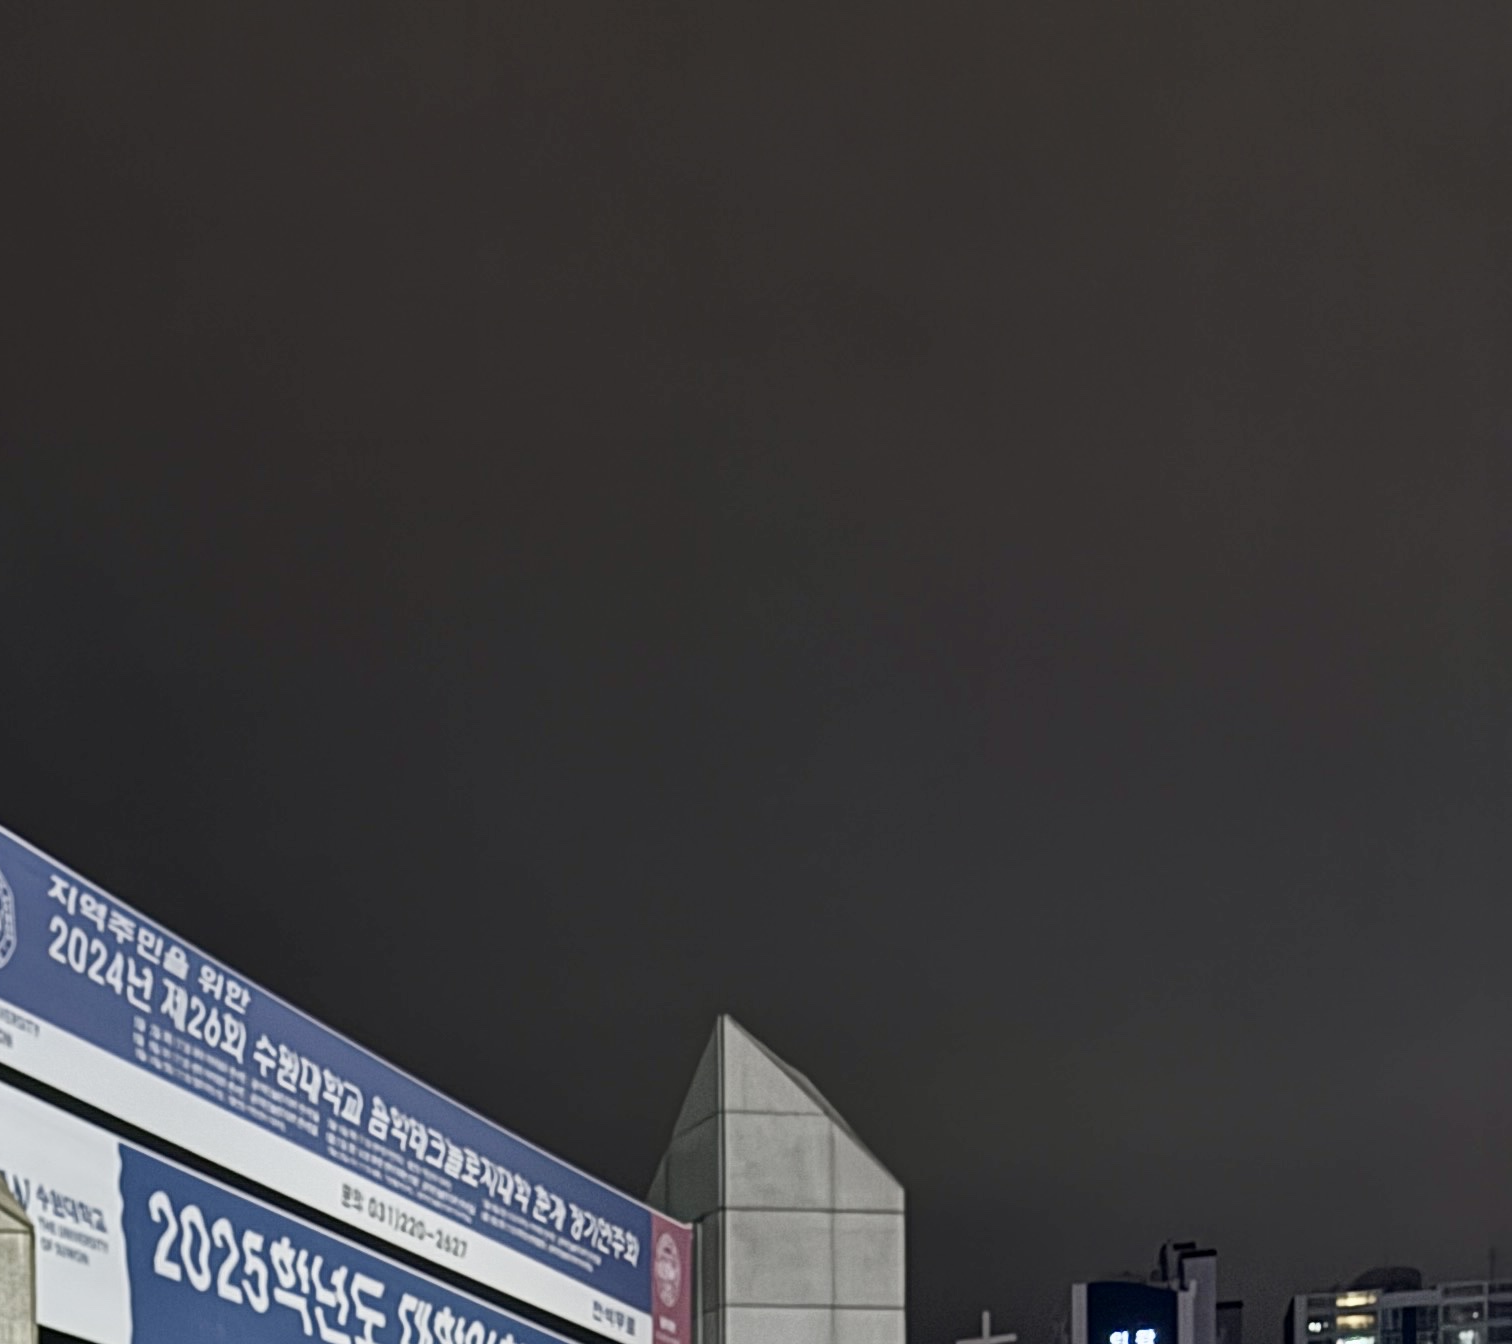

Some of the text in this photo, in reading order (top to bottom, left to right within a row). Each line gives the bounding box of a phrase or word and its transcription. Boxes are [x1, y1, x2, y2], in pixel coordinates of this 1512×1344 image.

[48, 875, 252, 1014] 지역주민을 위한
[49, 916, 154, 1013] 2024년
[161, 977, 247, 1065] 제26회
[254, 1033, 364, 1126] 수원대학교
[368, 1096, 532, 1213] 음악테크놀로지대학
[569, 1203, 641, 1268] 정기연주회
[36, 1184, 108, 1233] 수원대학교
